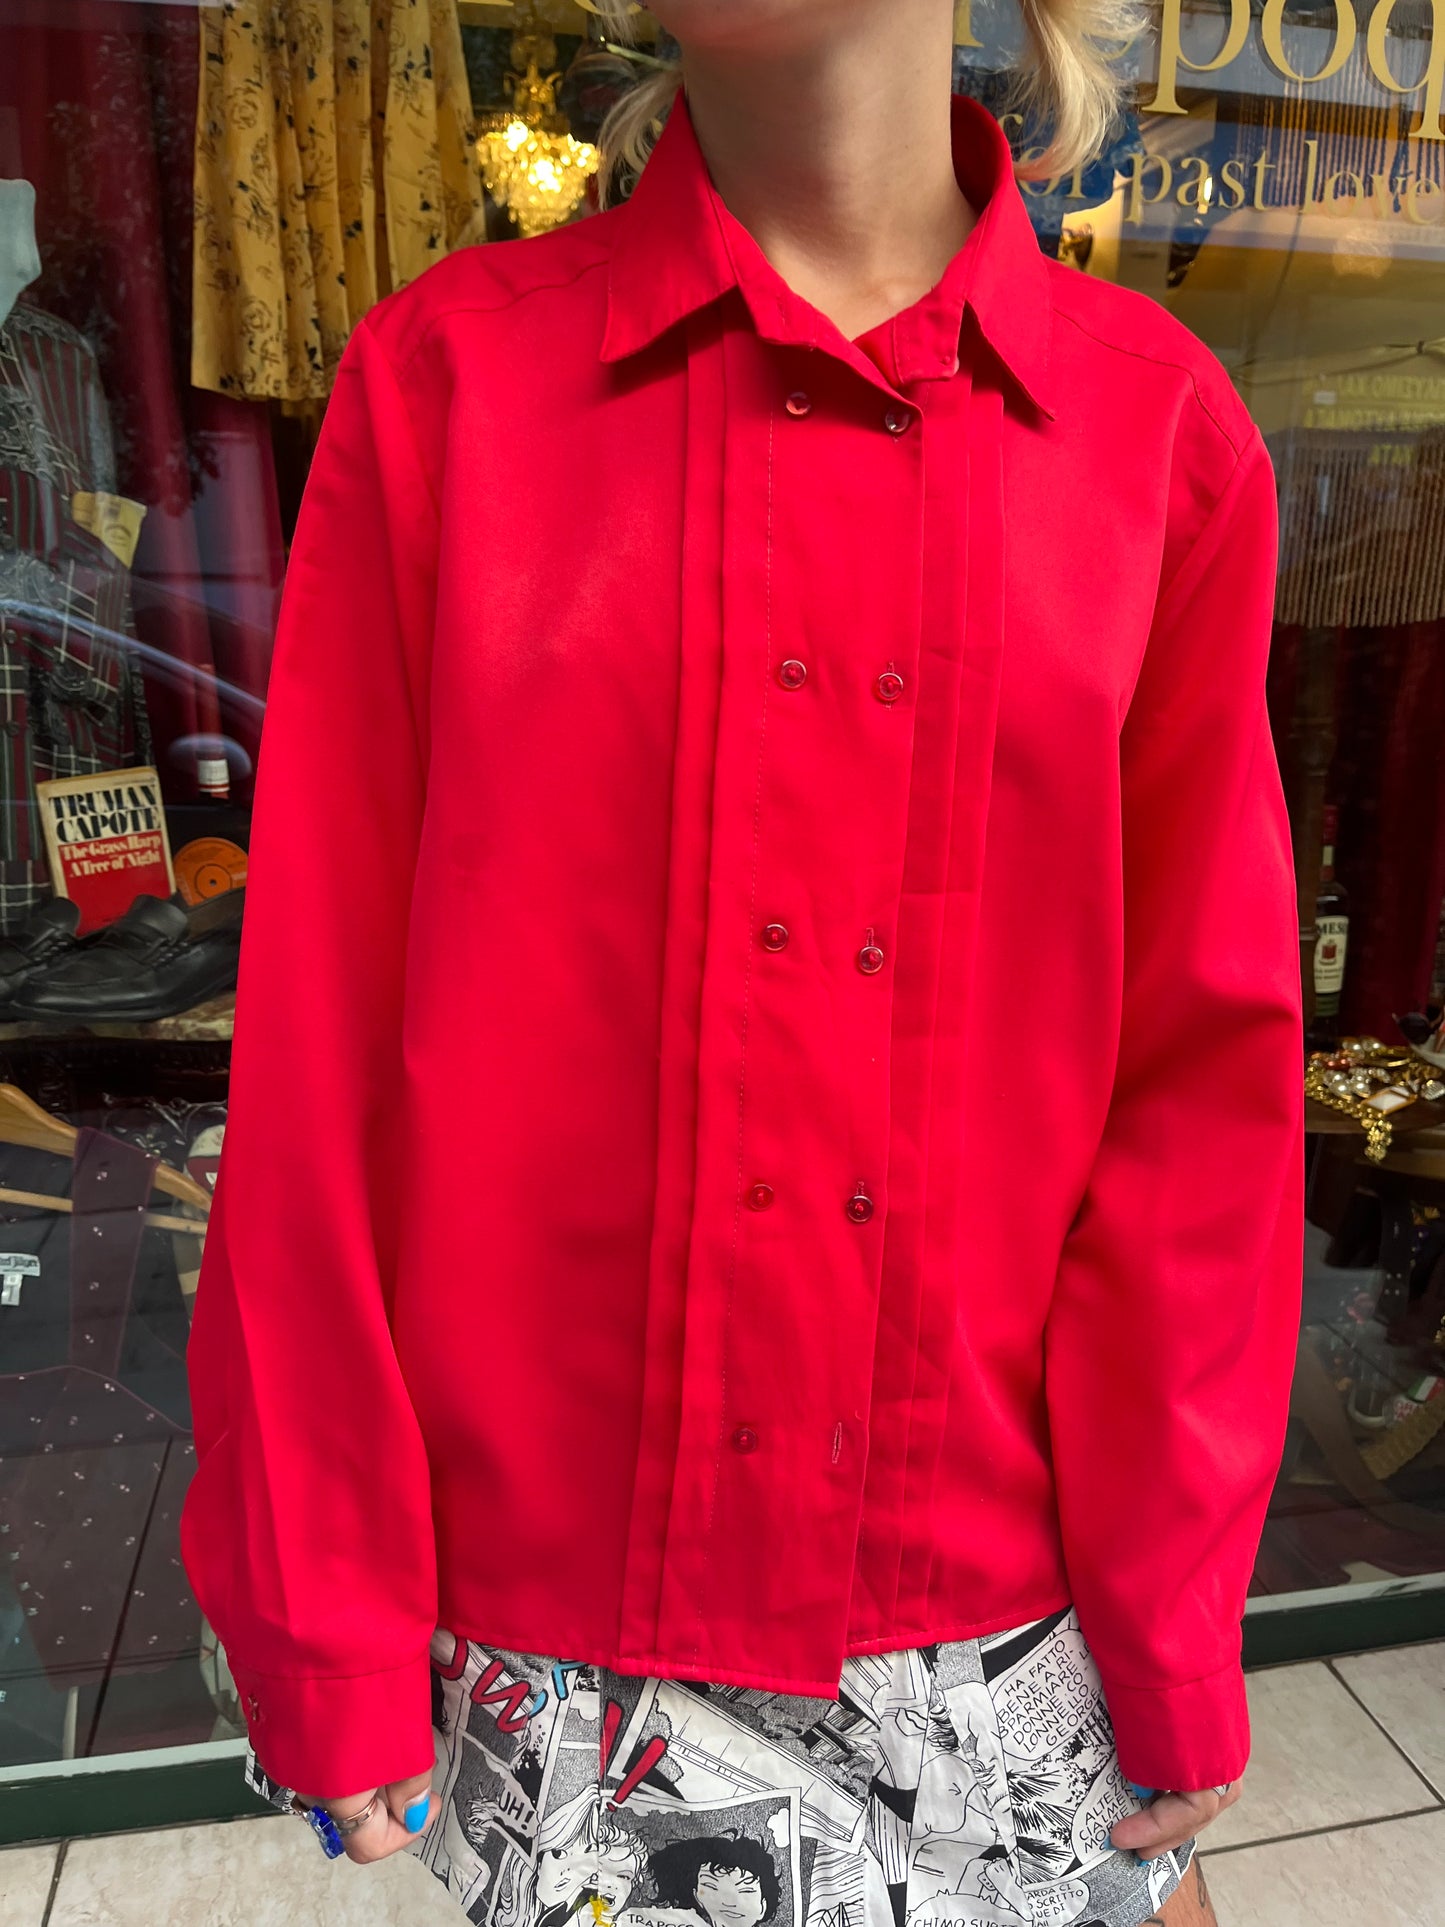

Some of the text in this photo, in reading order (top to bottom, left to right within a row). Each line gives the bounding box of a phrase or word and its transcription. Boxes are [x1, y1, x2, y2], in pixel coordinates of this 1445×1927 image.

[1123, 150, 1277, 223] past
[48, 784, 157, 820] TRUMAN
[56, 806, 161, 843] CAPOTE
[61, 834, 161, 861] The Grass Harp
[81, 857, 110, 876] Tree
[110, 854, 125, 871] of
[126, 847, 161, 868] Night
[1004, 1639, 1066, 1696] HA FATTO
[996, 1681, 1041, 1724] BENE
[1045, 1671, 1056, 1683] A
[1023, 1683, 1089, 1753] LONNELLO
[1045, 1688, 1100, 1746] GEORGE
[498, 1791, 535, 1830] UH!
[1036, 1889, 1084, 1909] SCRITTO
[1059, 1883, 1071, 1892] CI
